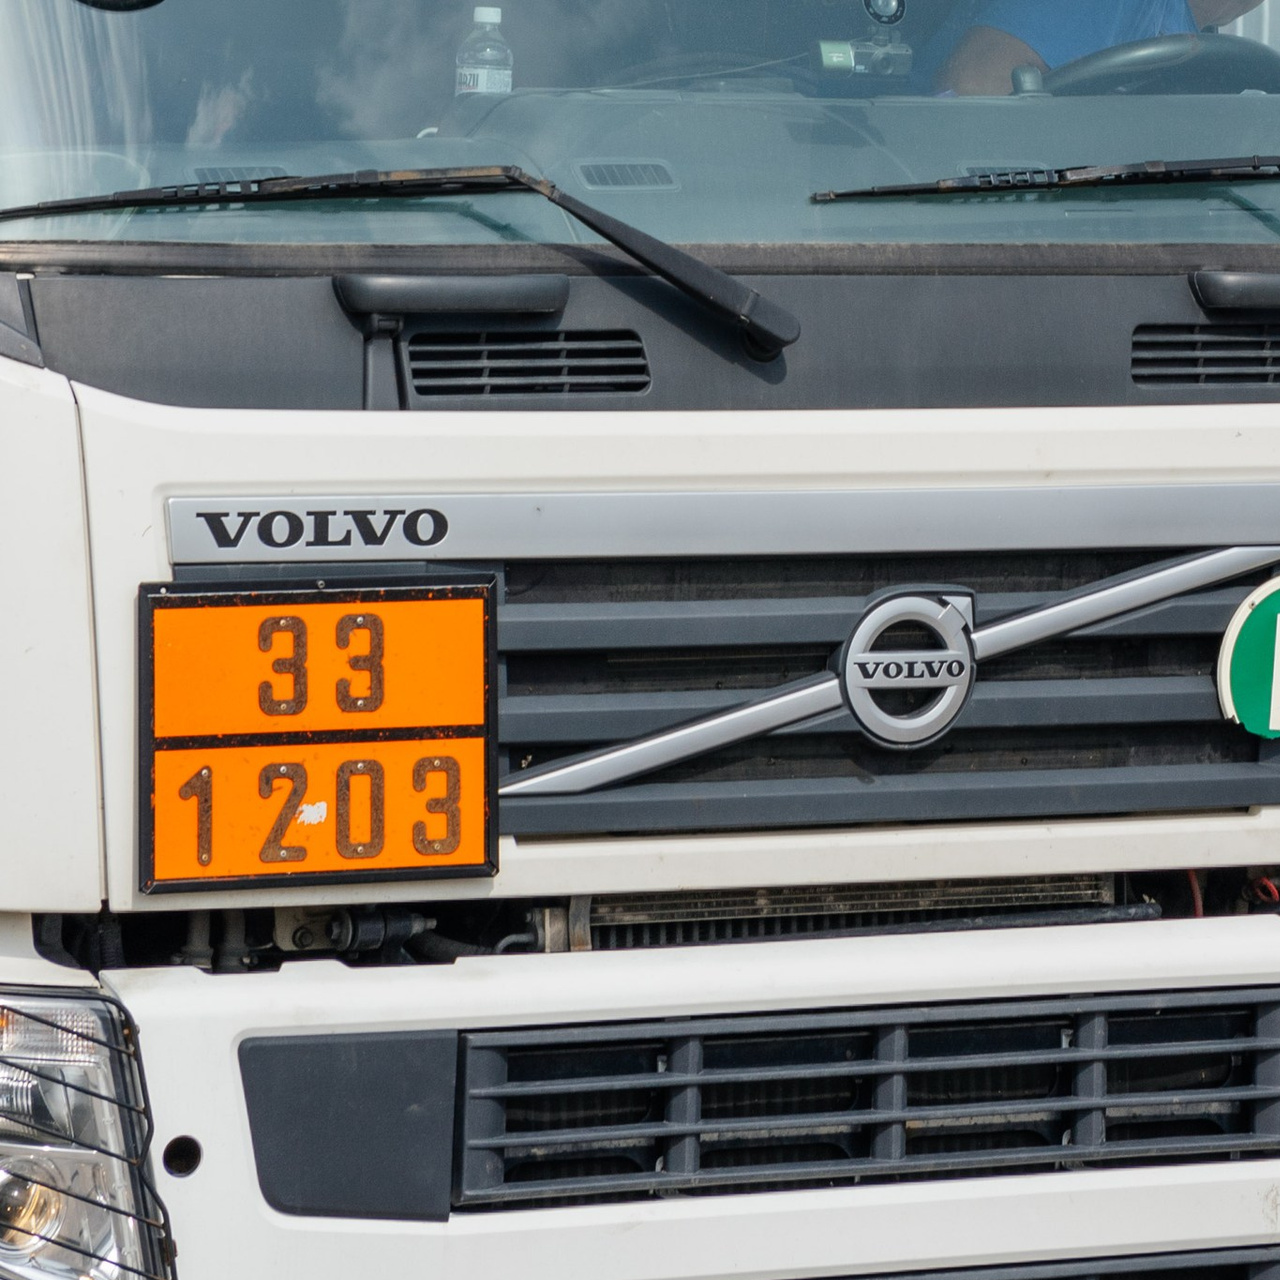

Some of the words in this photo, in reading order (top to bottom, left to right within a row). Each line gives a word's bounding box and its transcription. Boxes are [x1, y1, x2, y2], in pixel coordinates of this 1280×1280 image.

[196, 508, 449, 549] VOLVO
[257, 612, 385, 717] 33
[853, 660, 965, 680] VOLVO
[178, 755, 461, 867] 1203
